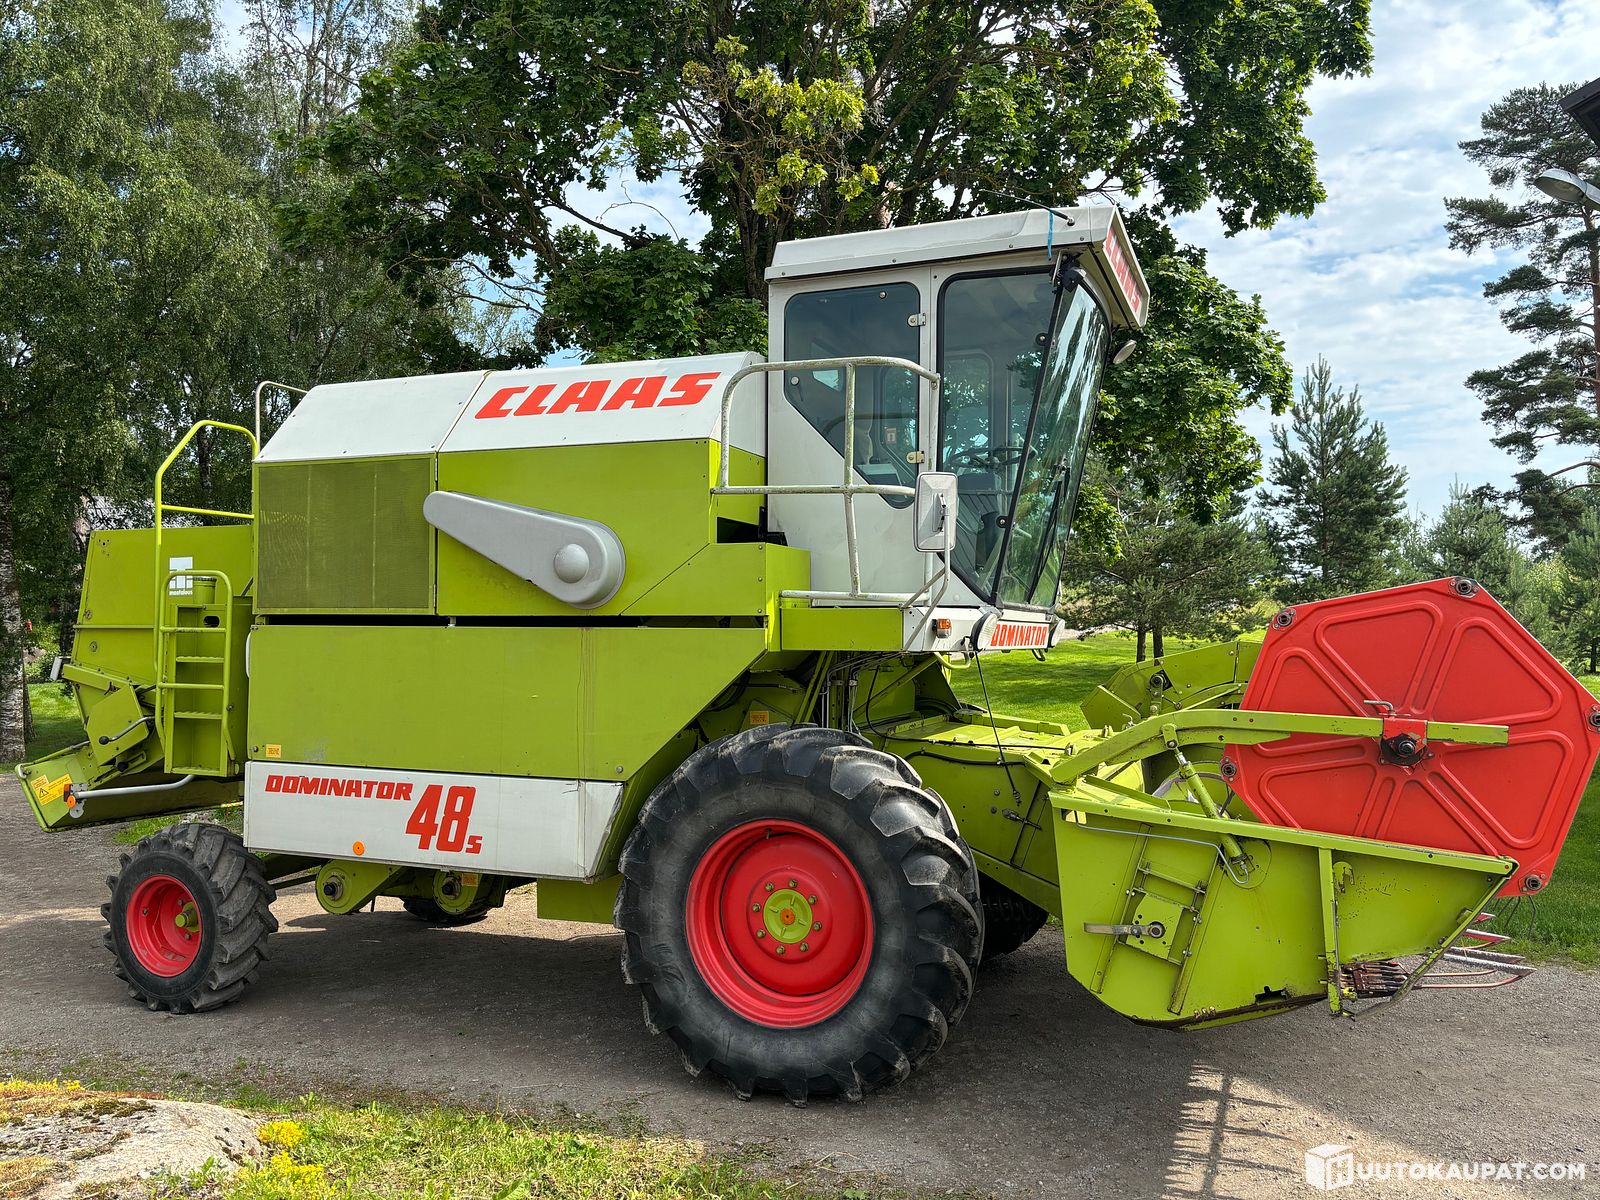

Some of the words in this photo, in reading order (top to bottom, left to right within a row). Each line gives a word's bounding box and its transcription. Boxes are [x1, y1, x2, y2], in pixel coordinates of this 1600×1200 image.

[474, 371, 721, 420] CLAAS
[991, 623, 1048, 647] DOMINATOR
[265, 774, 414, 801] DOMINATOR
